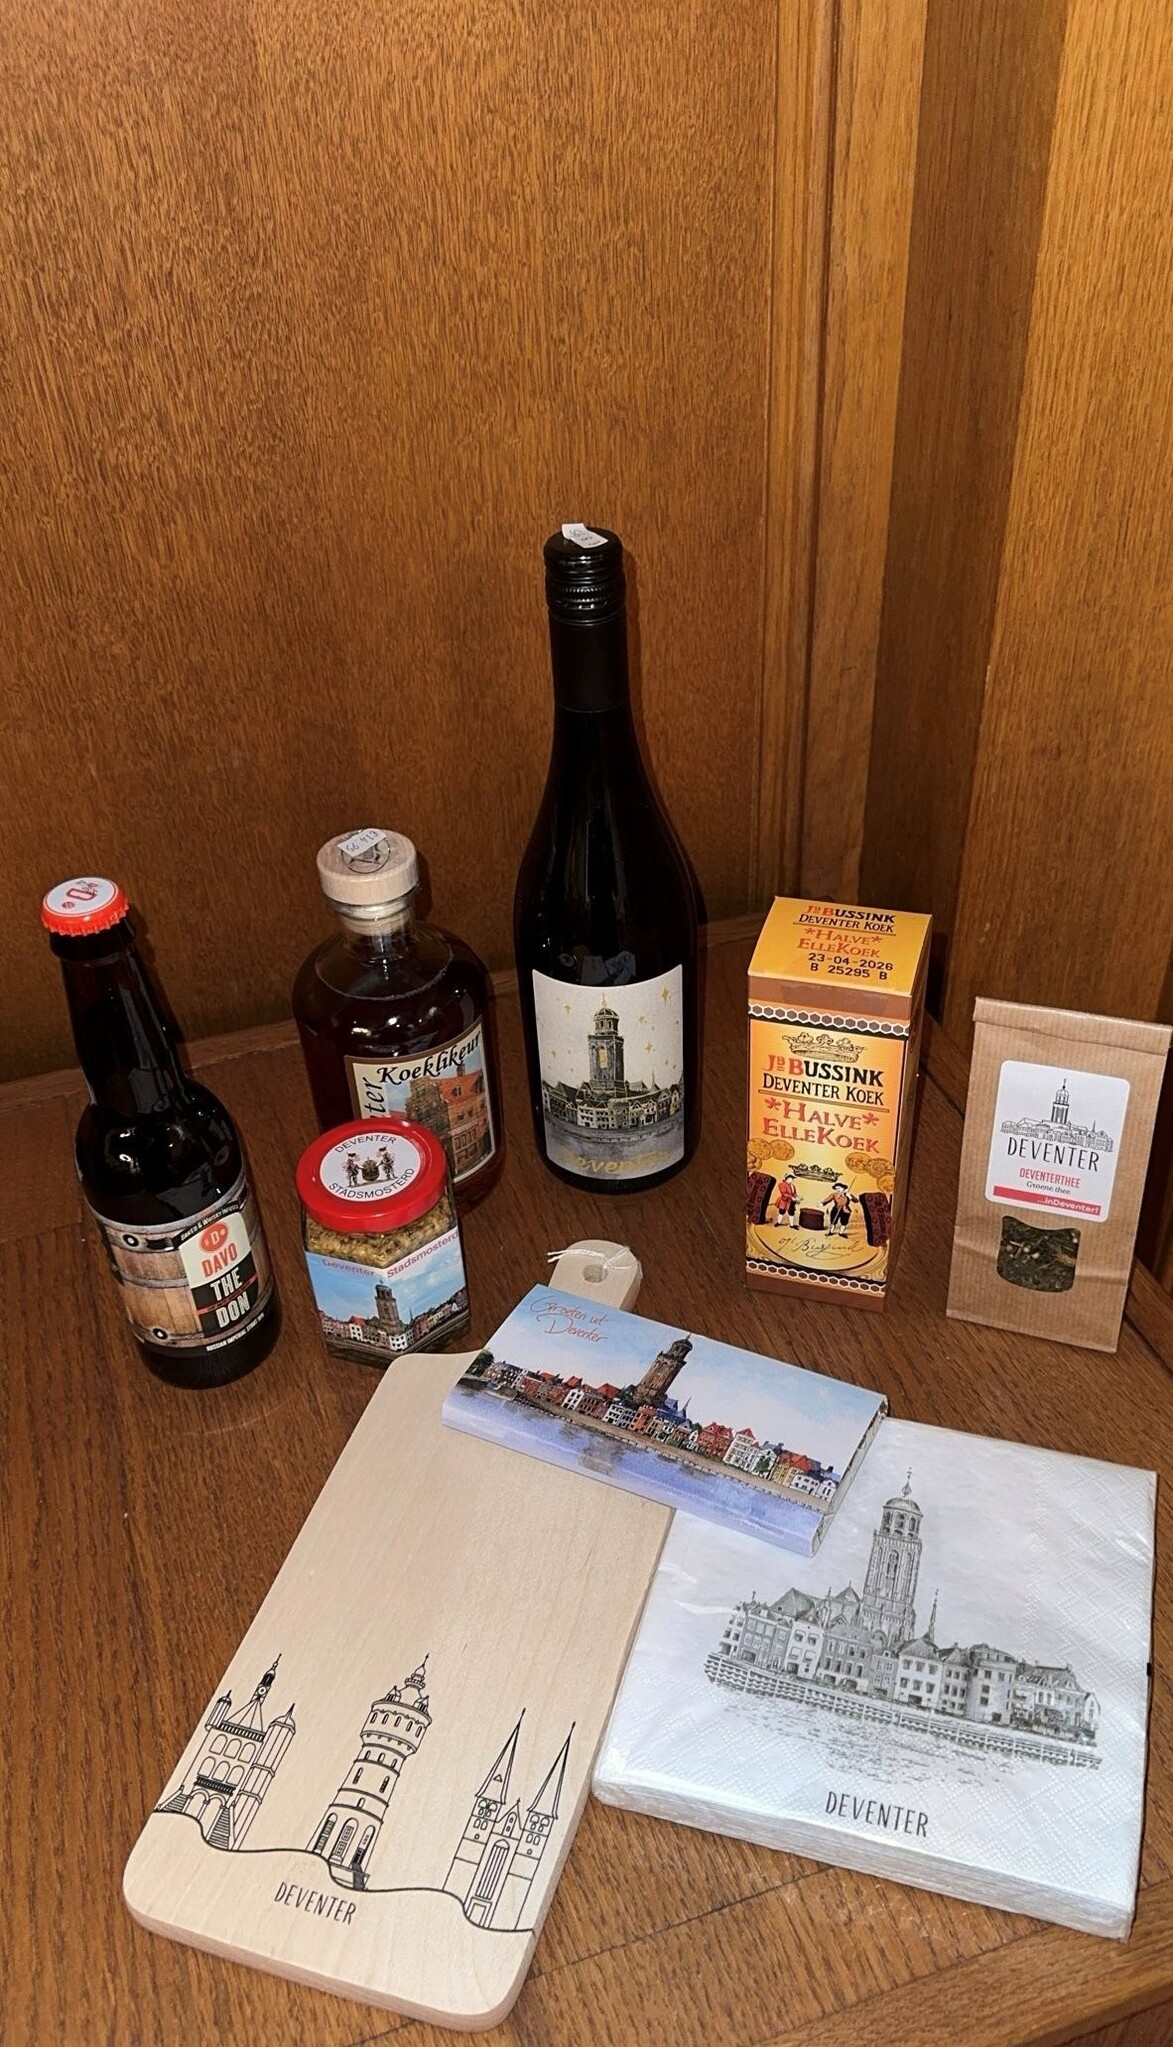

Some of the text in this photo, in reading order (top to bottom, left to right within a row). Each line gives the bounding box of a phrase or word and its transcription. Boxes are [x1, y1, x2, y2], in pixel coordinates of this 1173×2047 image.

[799, 914, 894, 933] DEVENTER KOEK
[822, 906, 895, 924] BUSSINK
[808, 952, 893, 971] 23-04-2026
[810, 963, 888, 980] B 25295 B
[377, 1030, 481, 1085] Koeklikeur
[788, 1057, 884, 1087] BUSSINK
[763, 1073, 884, 1106] DEVENTER KOEK
[334, 1134, 397, 1153] DEVENTER
[1007, 1137, 1100, 1172] DEVENTER
[328, 1168, 415, 1199] STADSMOSTERD
[1019, 1168, 1082, 1188] DEVENTERTHEE
[1026, 1181, 1071, 1195] Groene thee
[202, 1242, 238, 1278] DAVO
[322, 1259, 376, 1277] Deventer
[387, 1231, 459, 1278] Stadsmosterd
[210, 1266, 243, 1301] THE
[215, 1291, 251, 1329] DON
[530, 1296, 608, 1326] Groeten uit
[536, 1313, 608, 1342] Deventer
[825, 1790, 929, 1838] DEVENTER
[274, 1881, 357, 1926] DEVENTER
